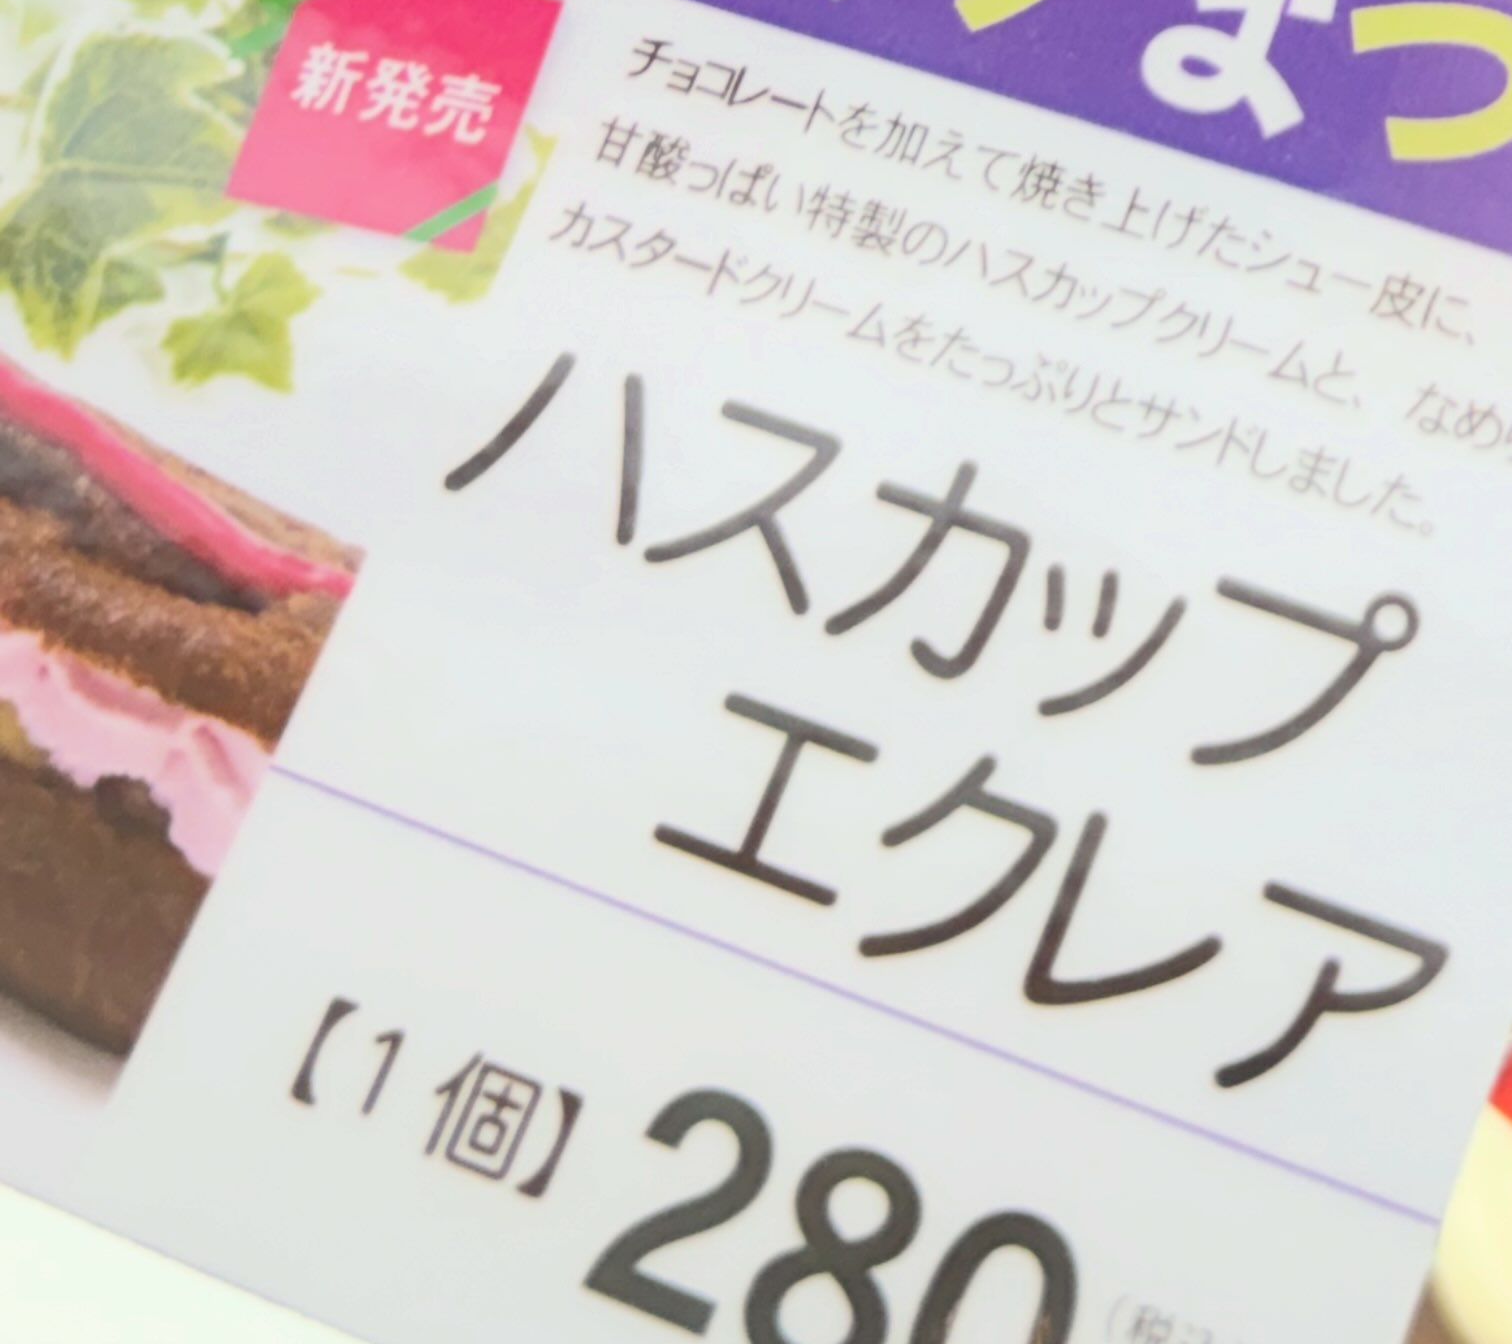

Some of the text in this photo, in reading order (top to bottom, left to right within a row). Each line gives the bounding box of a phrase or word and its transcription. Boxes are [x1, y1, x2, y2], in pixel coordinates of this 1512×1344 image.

[291, 42, 502, 145] 新発売
[444, 352, 1419, 765] ハスカップ
[653, 692, 1449, 1088] エクレア
